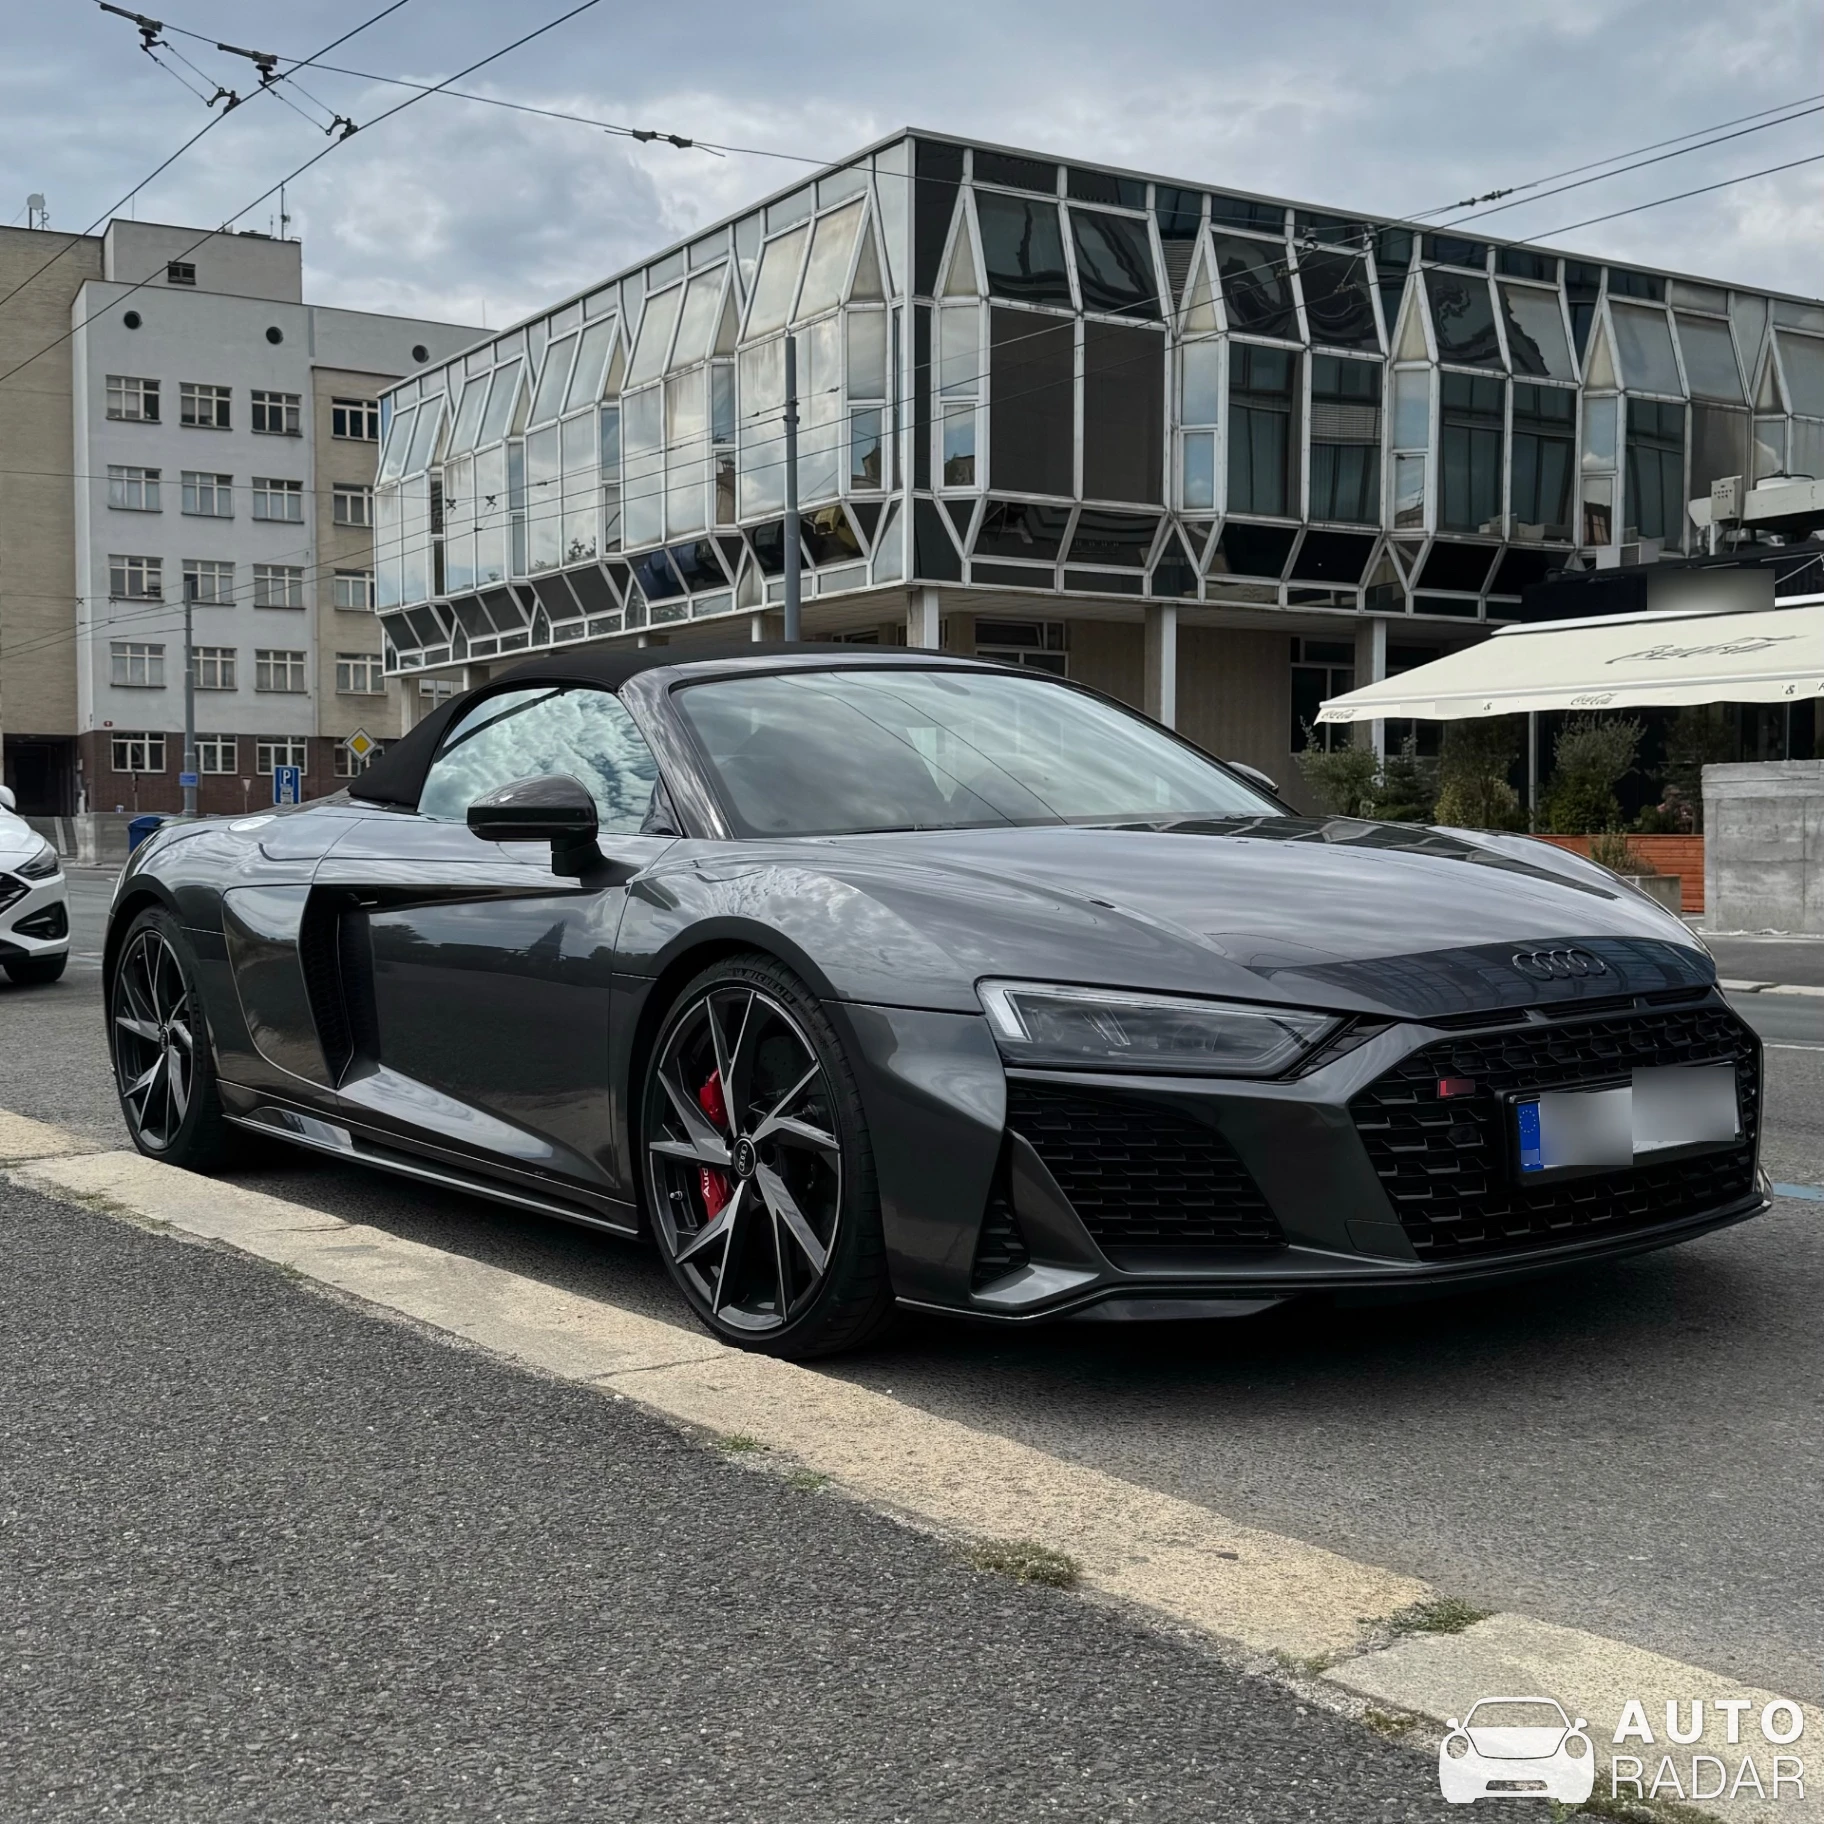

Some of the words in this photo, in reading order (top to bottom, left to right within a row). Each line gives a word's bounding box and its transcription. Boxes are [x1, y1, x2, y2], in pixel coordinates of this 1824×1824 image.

[283, 770, 291, 784] P
[744, 969, 794, 1004] MICHELIN
[702, 1167, 710, 1198] Aud
